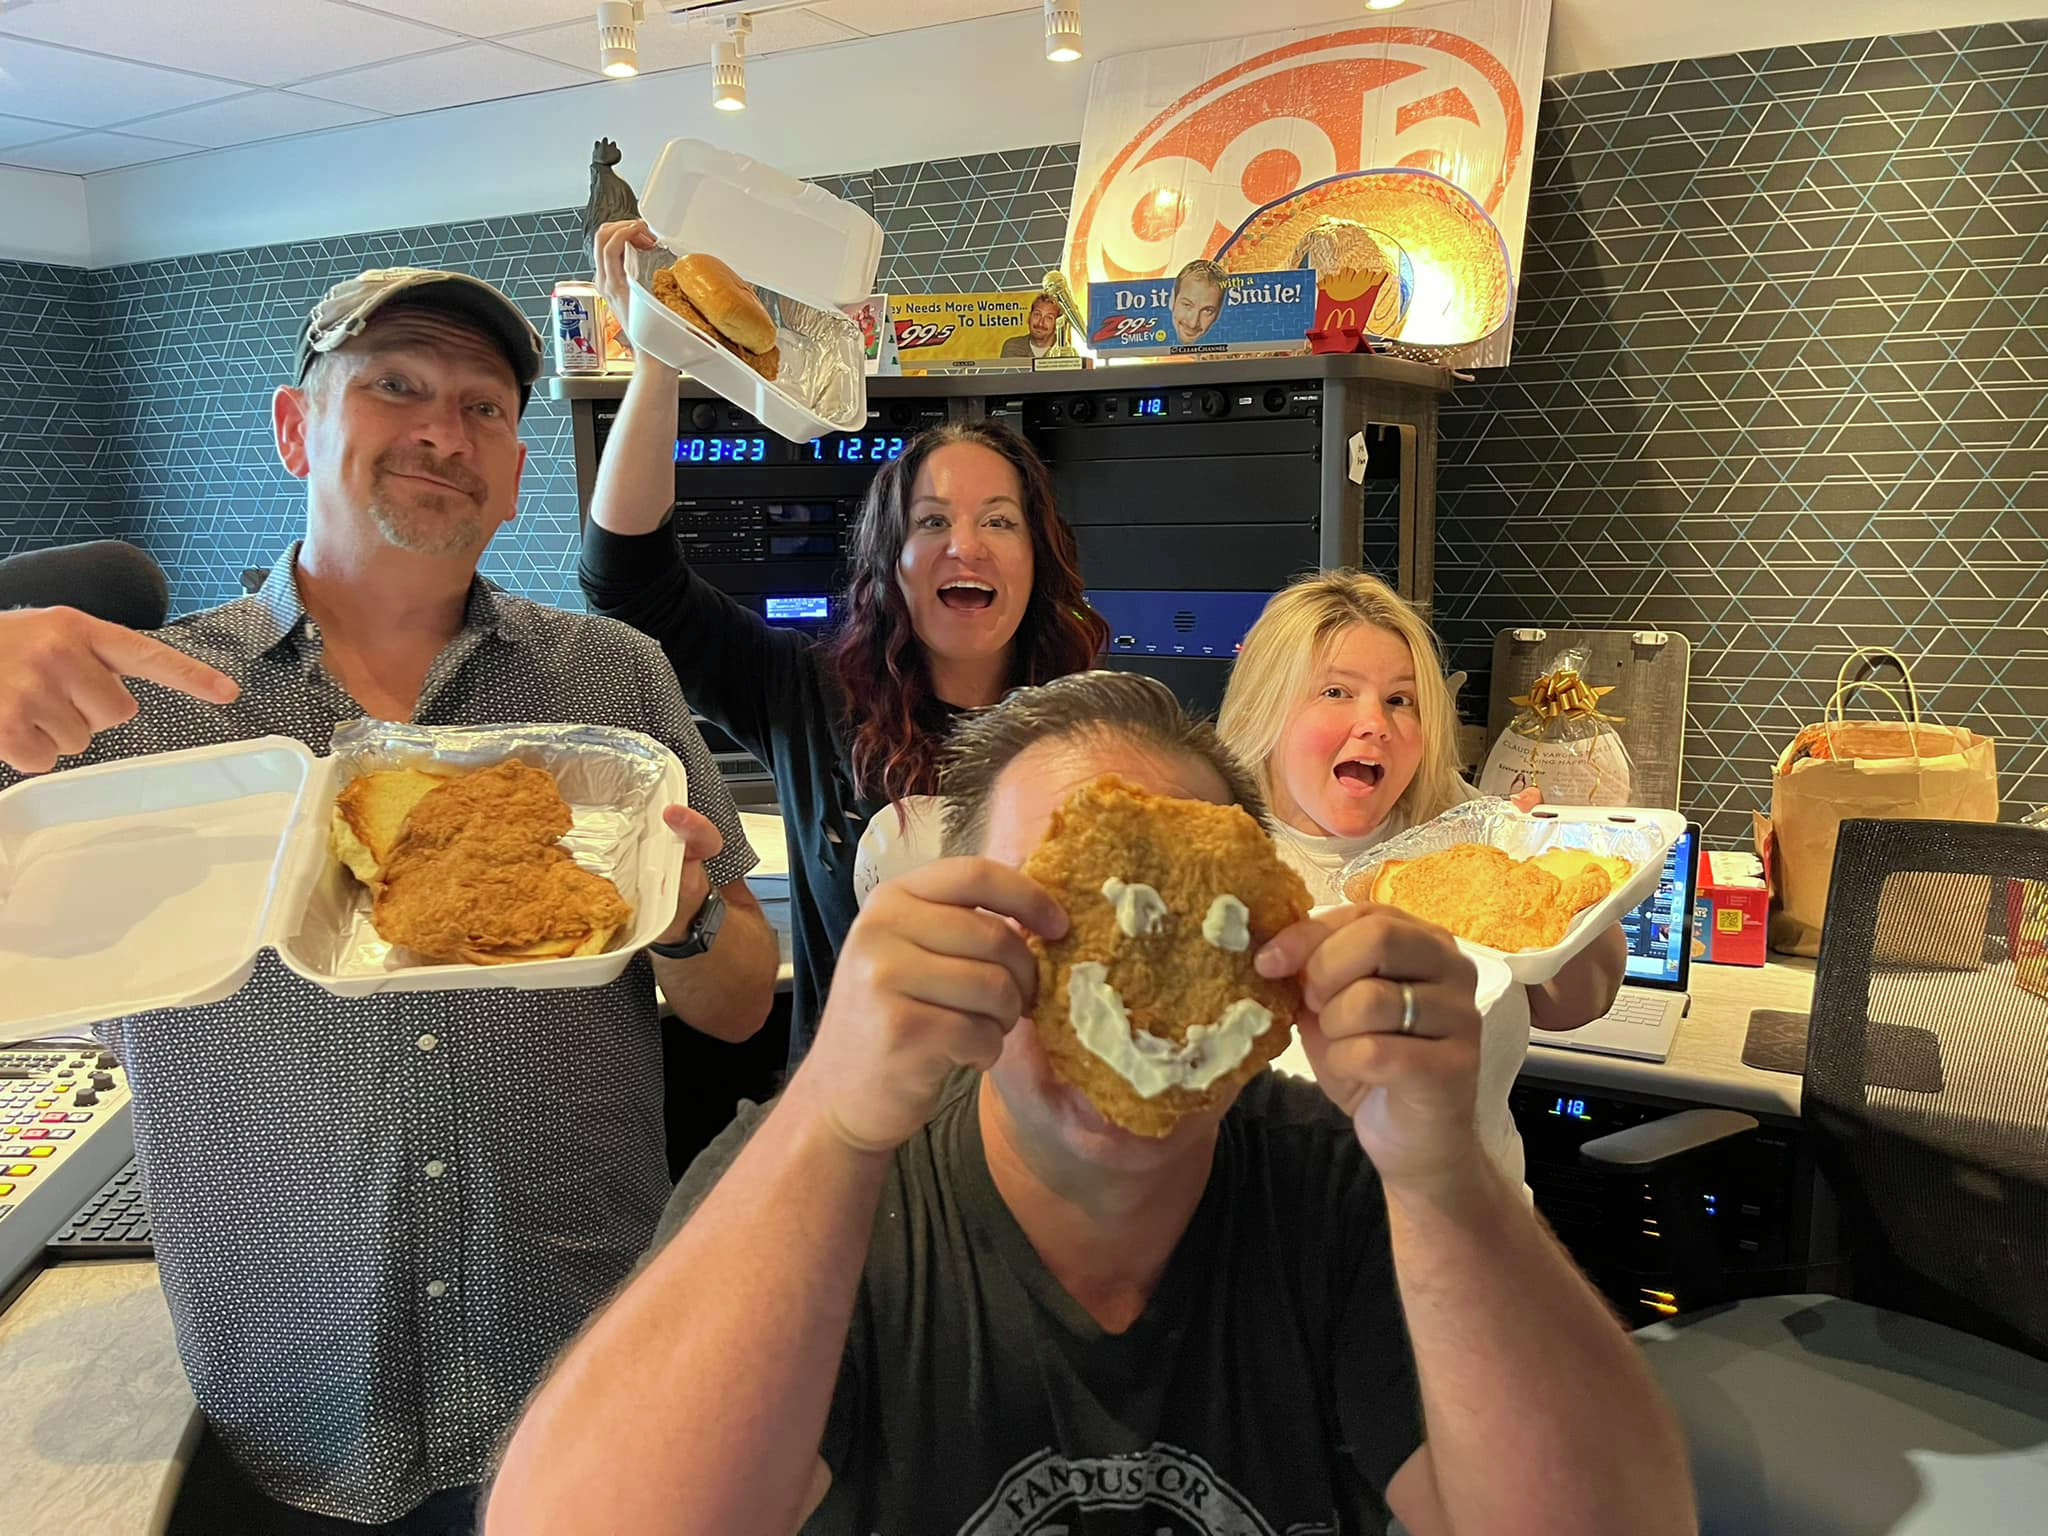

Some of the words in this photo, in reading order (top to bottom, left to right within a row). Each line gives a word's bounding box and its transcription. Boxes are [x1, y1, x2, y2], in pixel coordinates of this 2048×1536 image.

[1218, 277, 1245, 289] with
[1246, 277, 1254, 286] a
[1115, 290, 1146, 310] Do
[1150, 288, 1169, 308] it
[1228, 284, 1301, 306] Smile!
[906, 303, 941, 314] Needs
[945, 301, 974, 313] More
[958, 314, 975, 327] To
[979, 313, 1024, 328] Listen!
[1121, 331, 1155, 345] SMILEY
[1138, 398, 1161, 413] 118
[1555, 1097, 1585, 1115] 118
